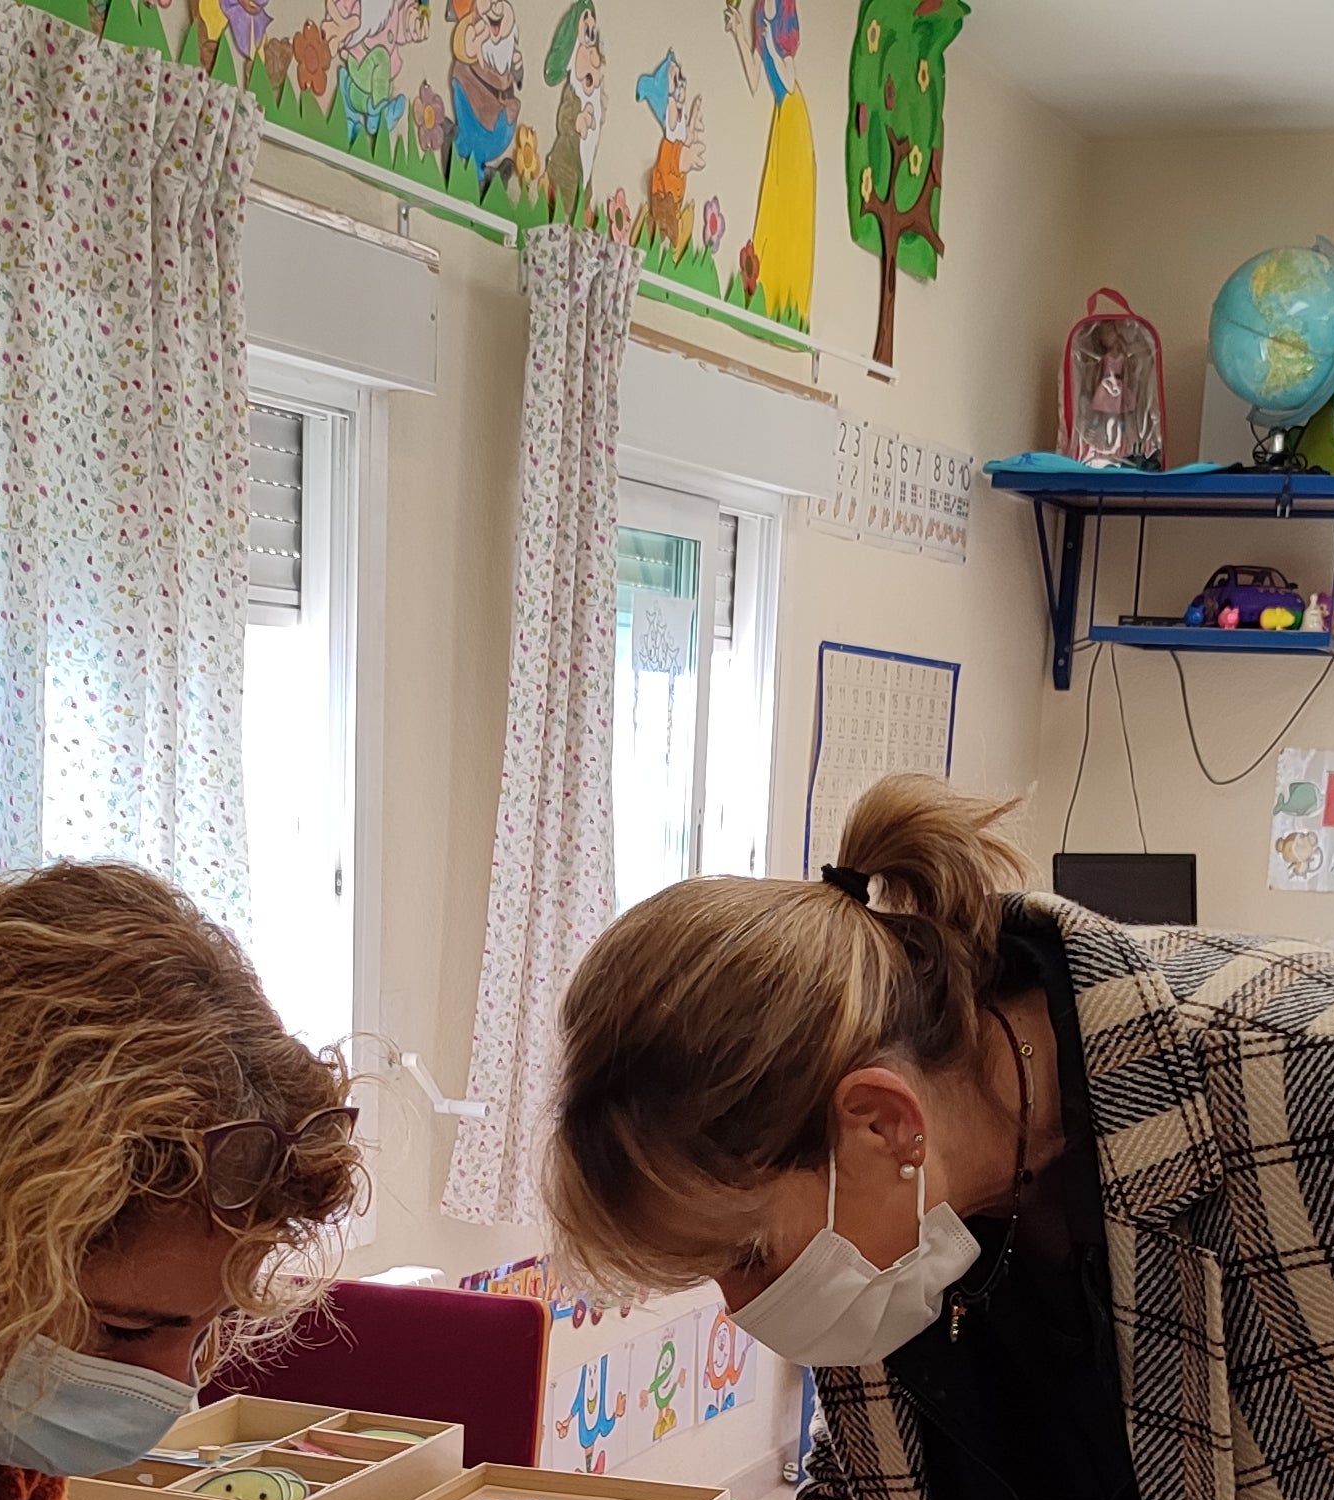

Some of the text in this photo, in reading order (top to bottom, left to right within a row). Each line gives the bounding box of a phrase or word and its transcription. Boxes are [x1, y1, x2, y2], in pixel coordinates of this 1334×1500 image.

[839, 422, 971, 492] 2 3 4 5 6 7 8 9 10
